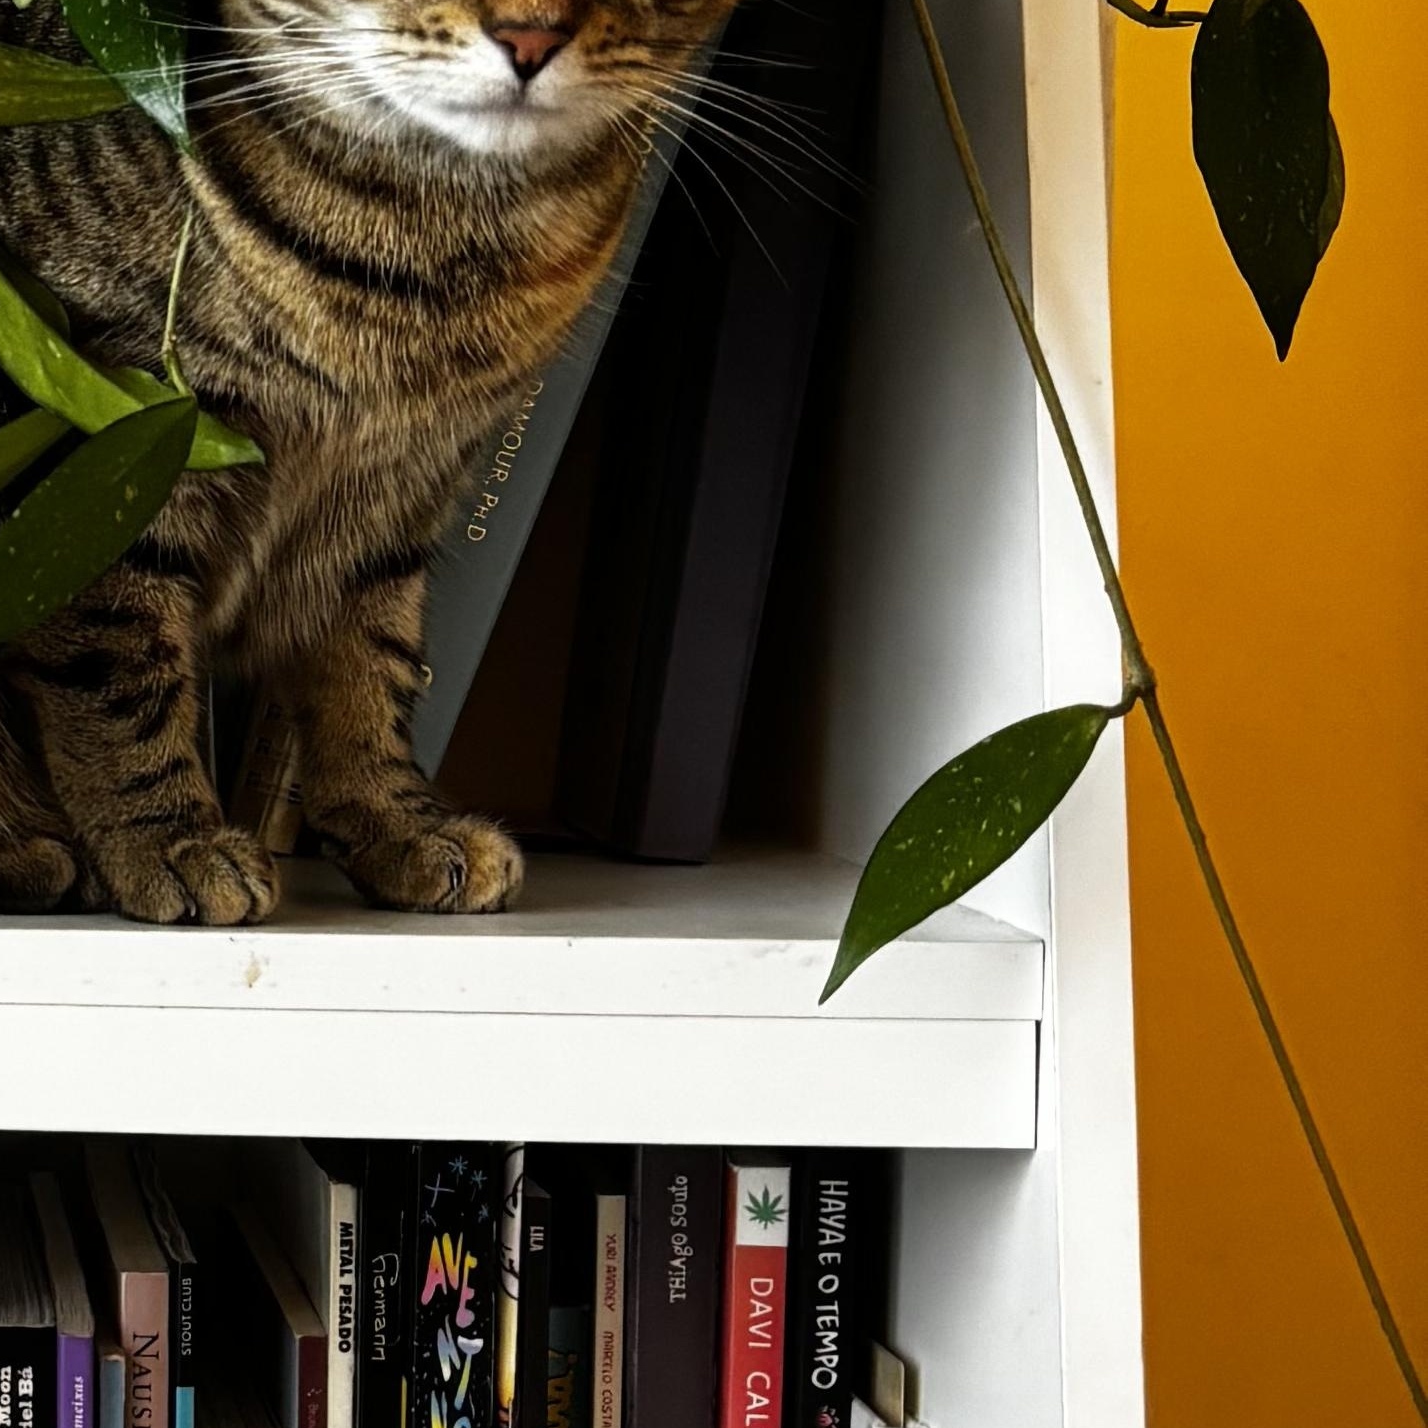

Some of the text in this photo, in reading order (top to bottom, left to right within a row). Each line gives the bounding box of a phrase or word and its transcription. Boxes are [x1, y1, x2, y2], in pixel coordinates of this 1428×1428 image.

[337, 1221, 354, 1279] METAL
[528, 1225, 544, 1252] LILA
[181, 1278, 195, 1313] CLUB
[336, 1283, 354, 1354] PESADO
[748, 1276, 774, 1349] DAVI
[811, 1300, 841, 1391] TEMPO
